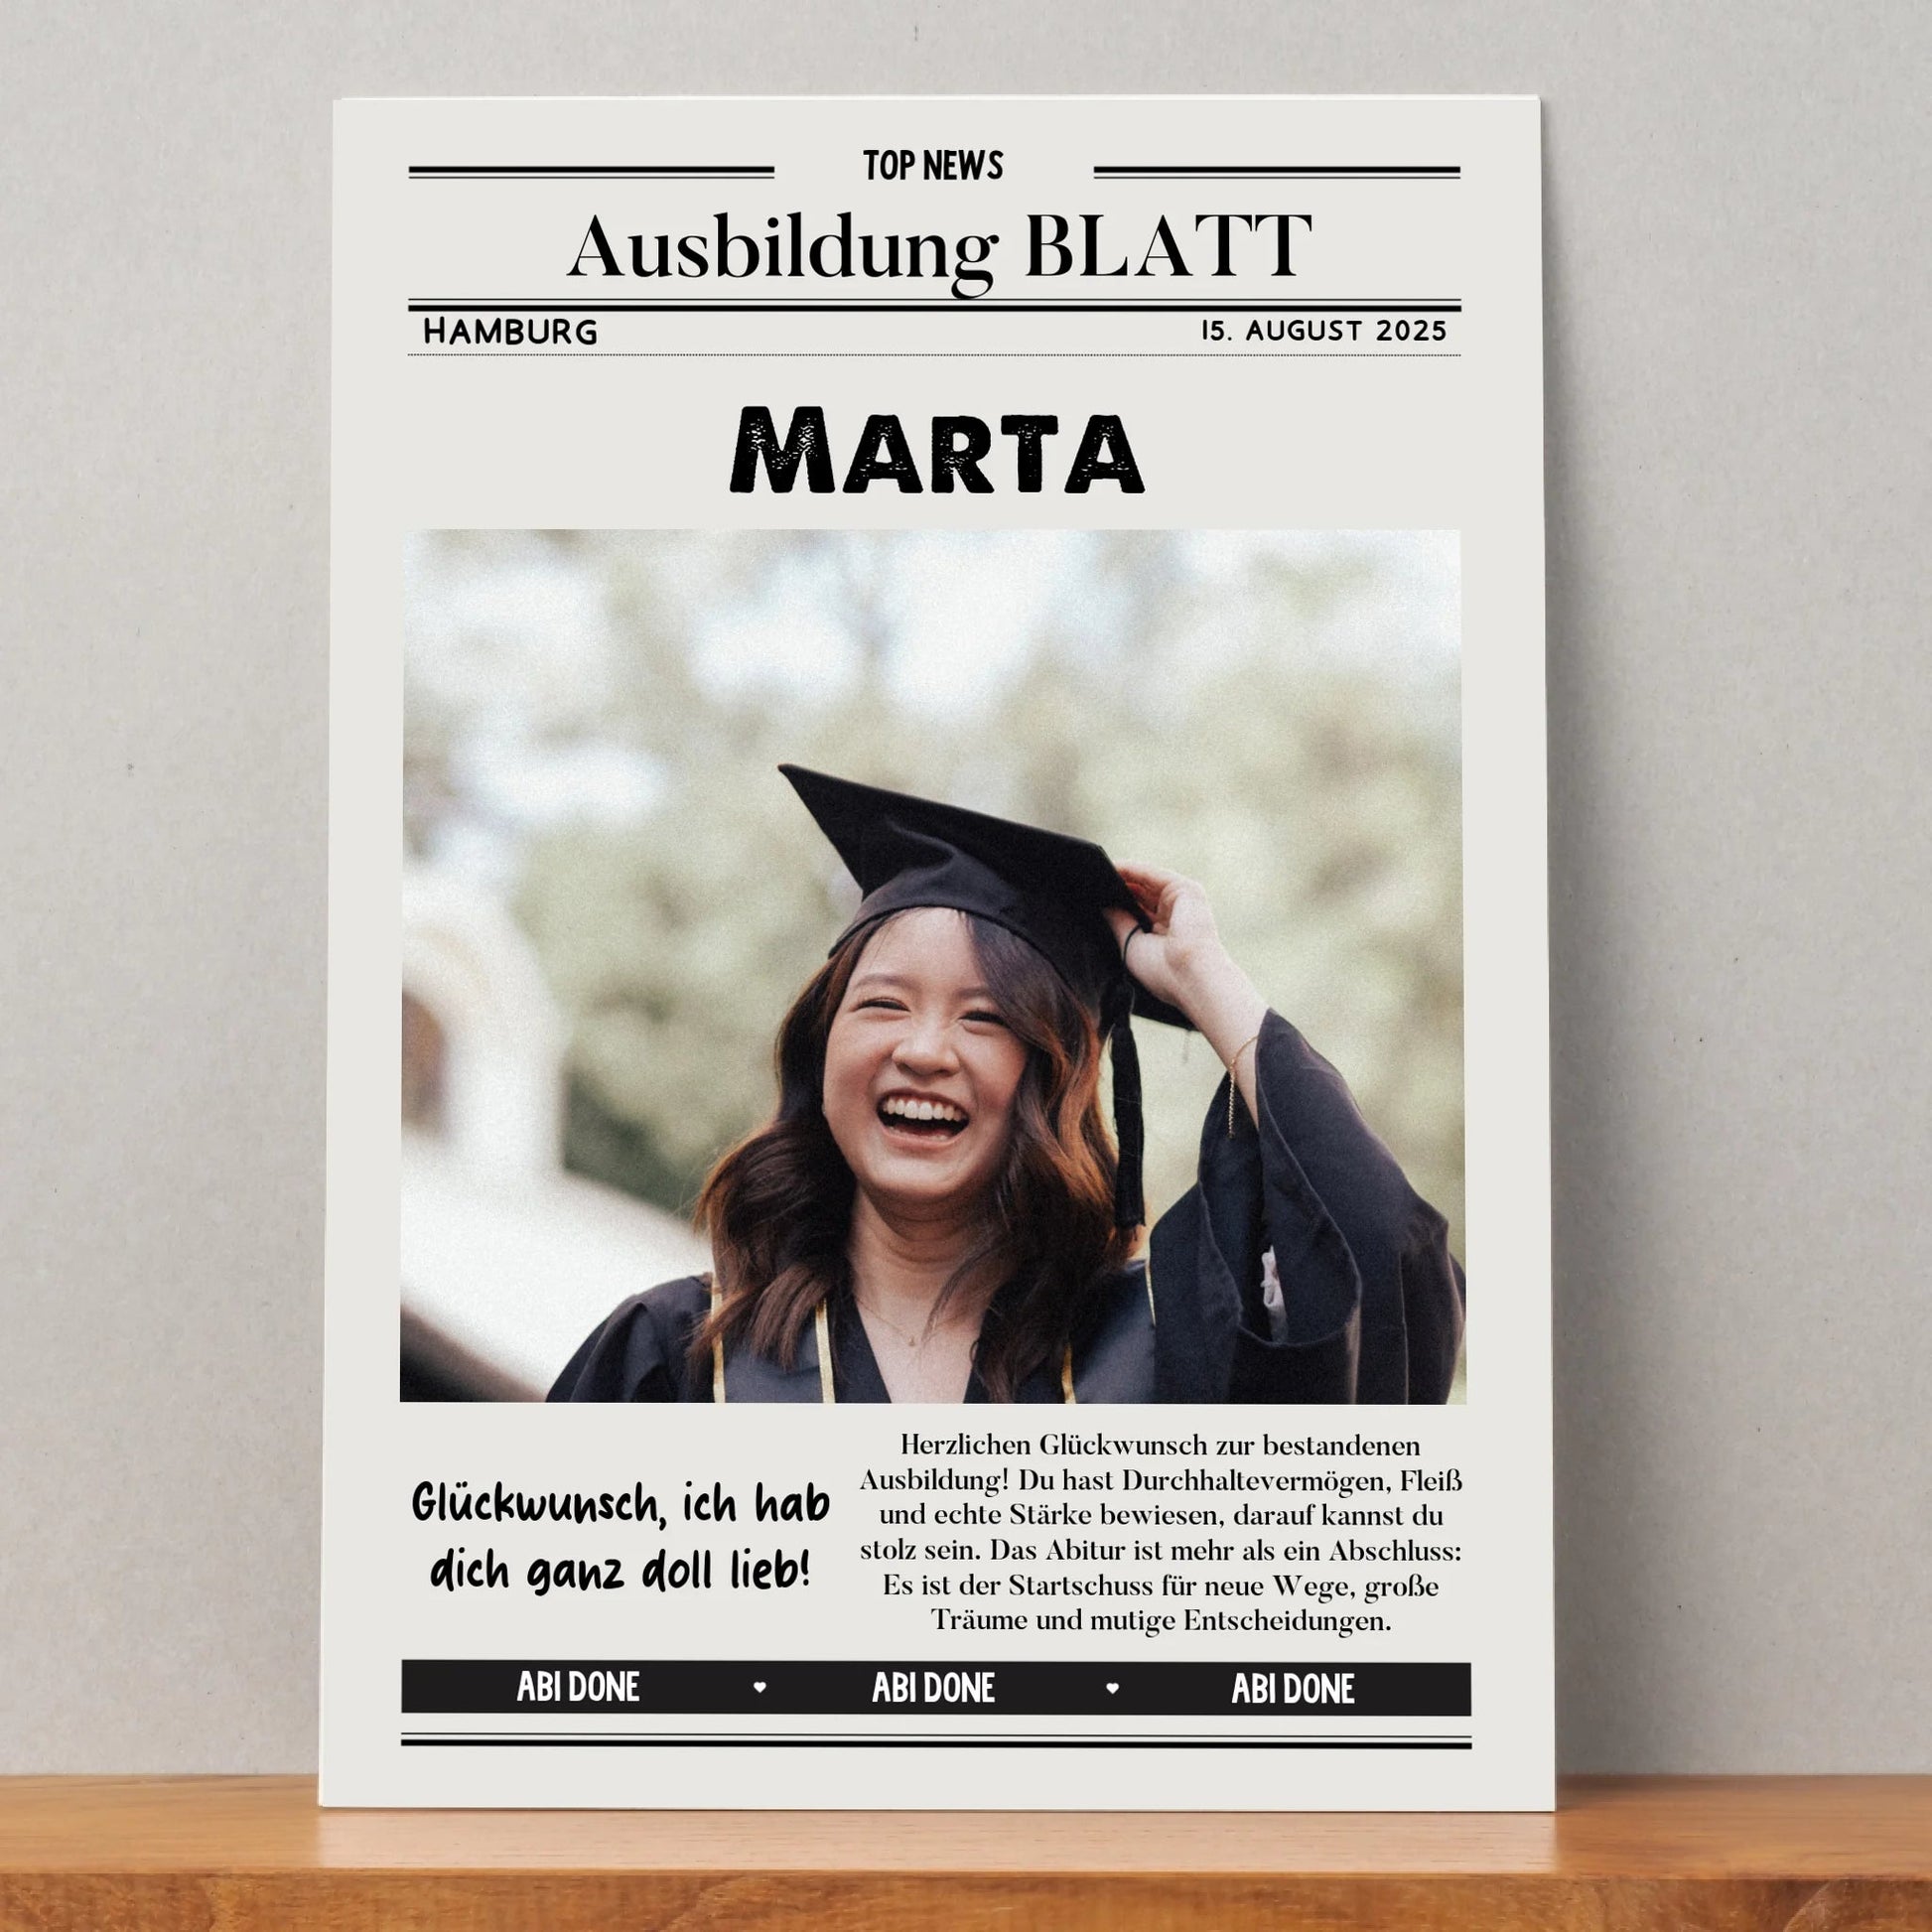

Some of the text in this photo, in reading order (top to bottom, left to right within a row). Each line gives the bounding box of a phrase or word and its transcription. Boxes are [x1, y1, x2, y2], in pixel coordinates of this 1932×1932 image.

[864, 150, 1004, 180] TOP NEWS
[567, 211, 1311, 300] Ausbildung BLATT
[425, 317, 597, 345] HAMBURG
[1203, 320, 1446, 341] 15. AUGUST 2025
[902, 1433, 1420, 1455] Herzlichen Glückwunsch zur bestandenen
[861, 1468, 1462, 1498] Ausbildung! Du hast Durchhaltevermögen, Fleiß
[413, 1481, 829, 1531] Glückwunsch, ich hab
[881, 1503, 1443, 1527] und echte Stärke bewiesen, darauf kannst du
[861, 1538, 1460, 1561] stolz sein. Das Abitur ist mehr als ein Abschluss:
[431, 1547, 808, 1596] dich ganz doll lieb!
[885, 1574, 1439, 1602] Es ist der Startschuss für neue Wege, große
[931, 1608, 1391, 1638] Träume und mutige Entscheidungen.
[517, 1671, 1354, 1704] ABI DONE ABI DONE ABI DONE
